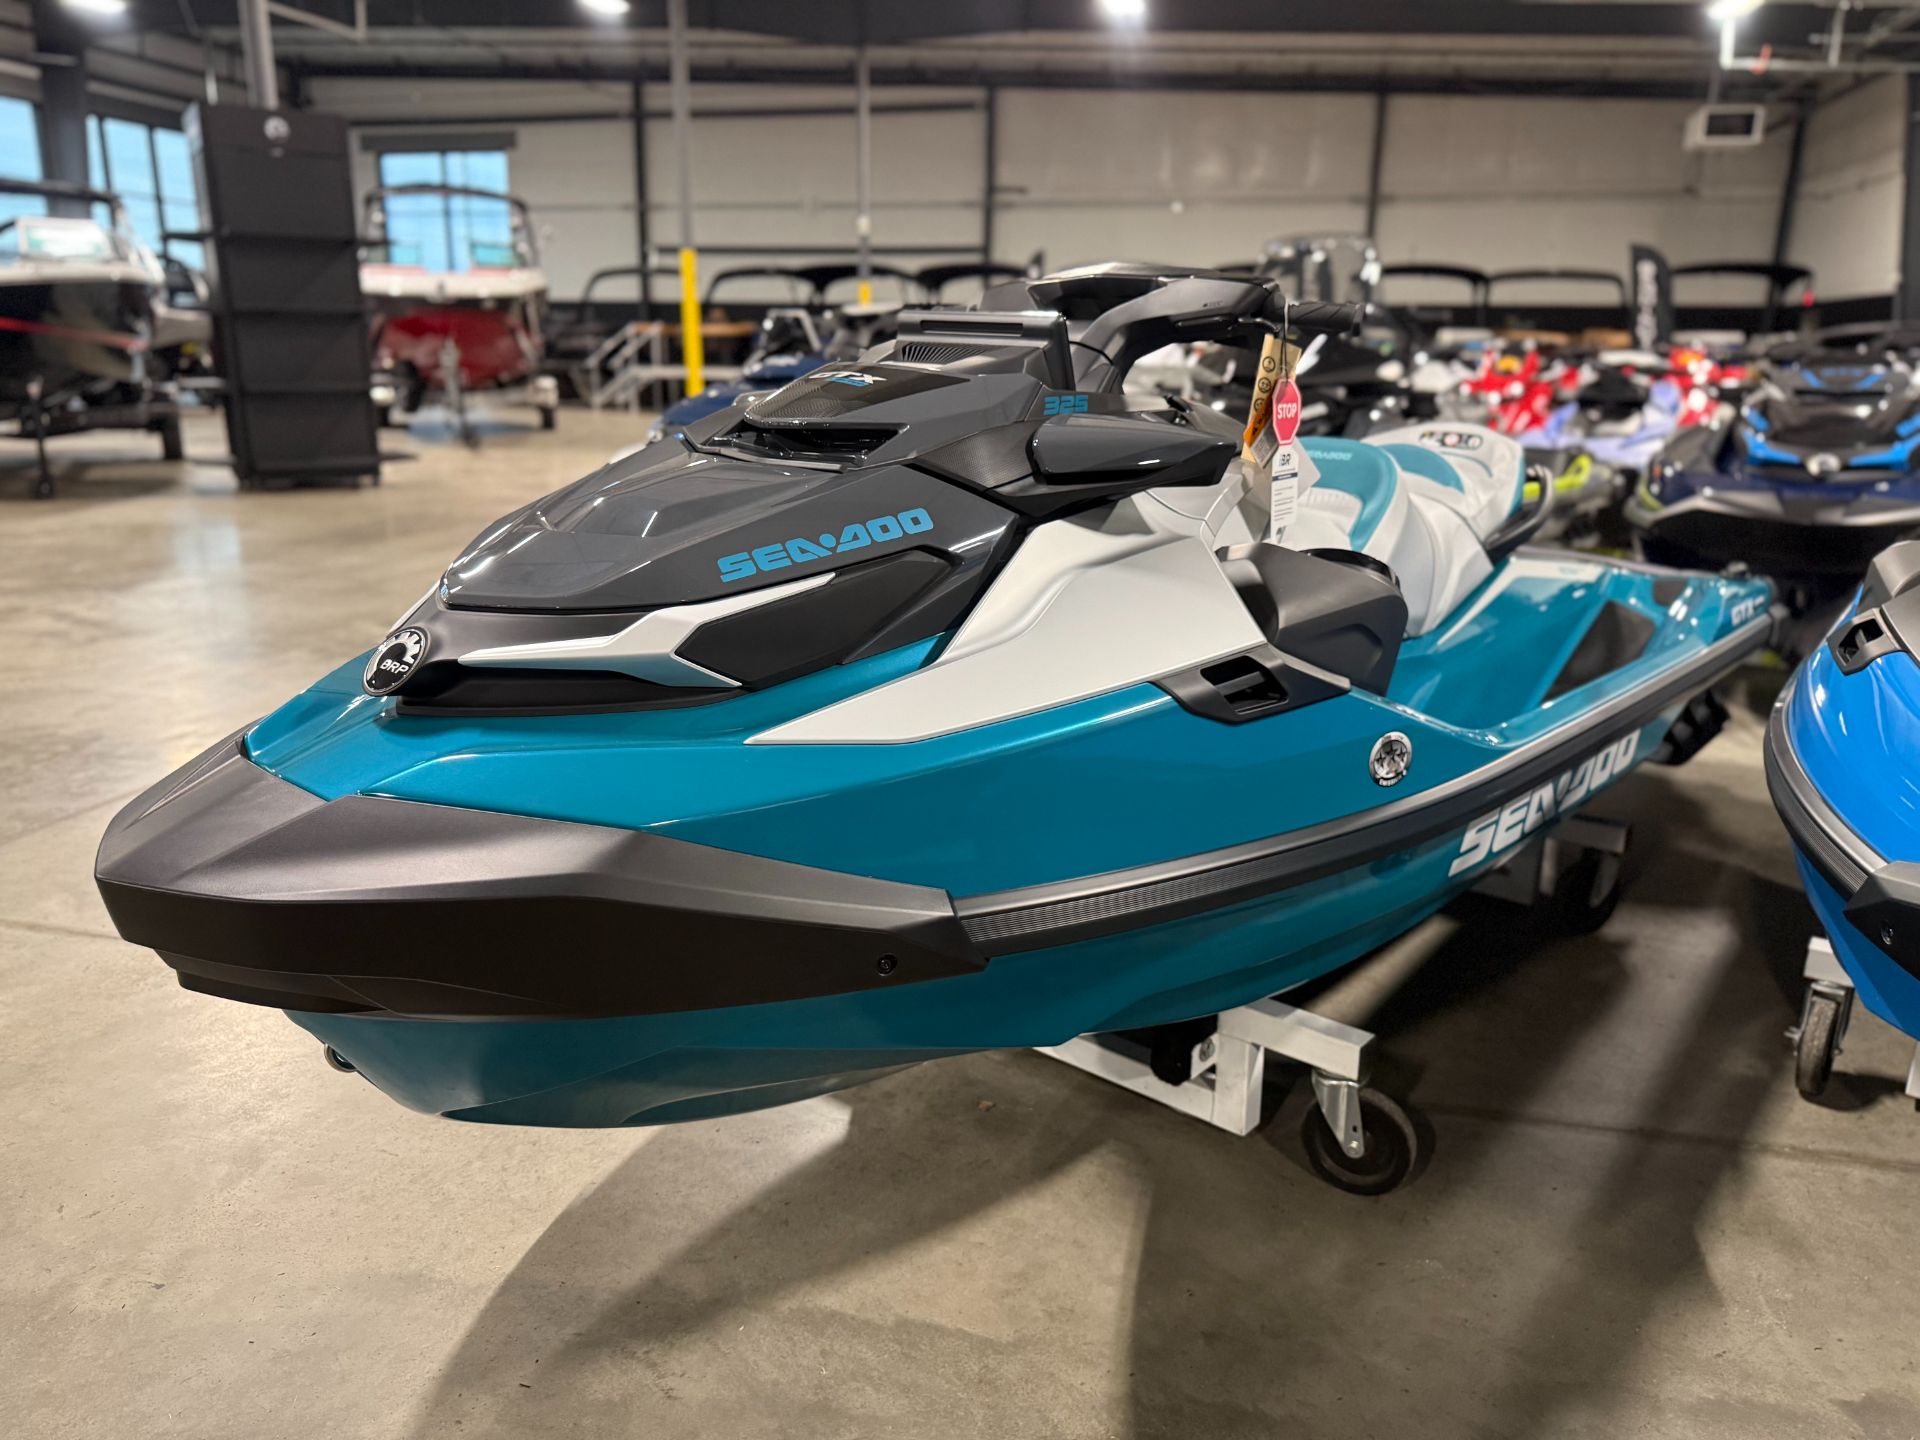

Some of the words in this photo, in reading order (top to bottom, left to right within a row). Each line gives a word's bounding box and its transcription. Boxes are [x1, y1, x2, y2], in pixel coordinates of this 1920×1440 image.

[1043, 394, 1089, 416] 325
[1277, 403, 1298, 419] STOP
[379, 658, 409, 674] BRP
